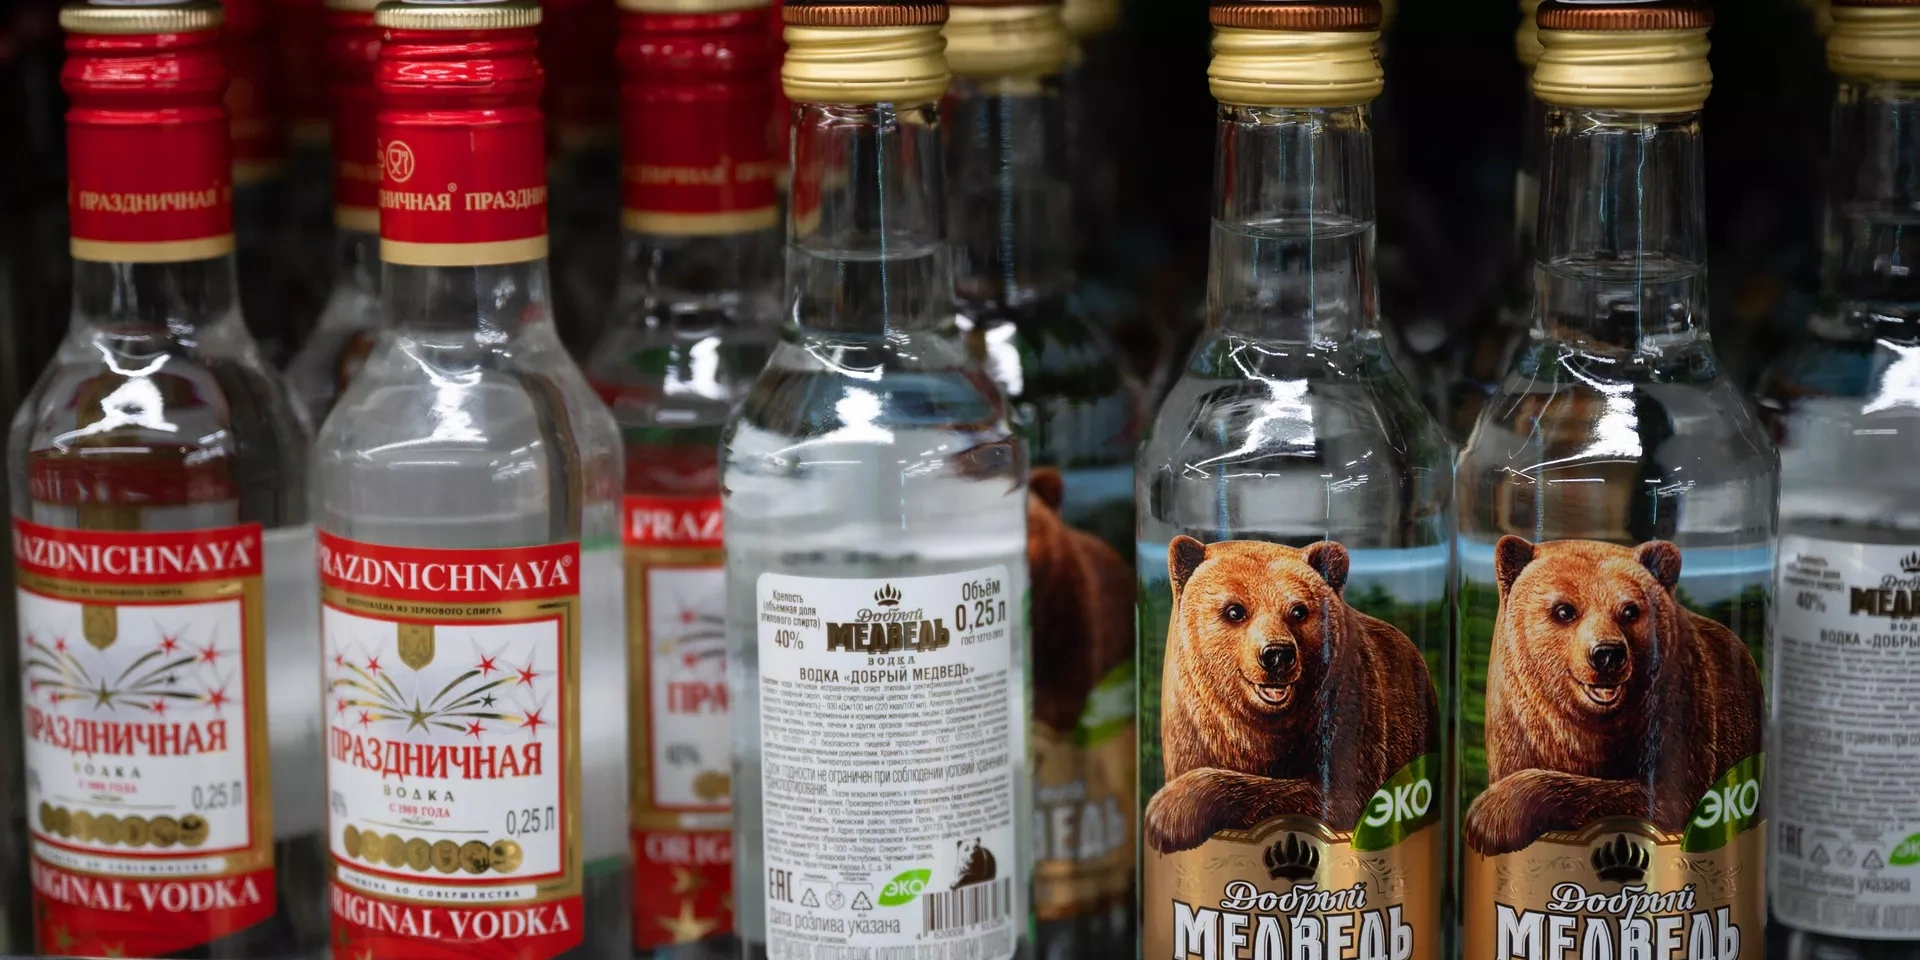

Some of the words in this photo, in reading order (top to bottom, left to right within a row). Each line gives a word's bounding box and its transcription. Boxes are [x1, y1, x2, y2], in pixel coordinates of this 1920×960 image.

[80, 189, 216, 215] ПРАЗДНИЧНАЯ
[772, 589, 803, 603] Крепость
[962, 579, 1000, 601] Объём
[410, 605, 463, 616] ЗЕРНОВОГО
[466, 606, 502, 616] СПИРТА
[799, 607, 816, 616] доля
[855, 608, 924, 625] Добрый
[955, 599, 994, 633] 0,25
[998, 600, 1006, 622] л
[793, 617, 820, 630] спирта)
[775, 629, 804, 649] 40%
[826, 618, 950, 654] МЕДВЕДЬ
[961, 635, 975, 646] ГОСТ
[1820, 629, 1860, 645] ВОДКА
[867, 656, 916, 666] ВОДКА
[800, 667, 839, 683] ВОДКА
[844, 666, 907, 684] «ДОБРЫЙ
[912, 663, 975, 681] МЕДВЕДЬ»
[856, 722, 876, 730] других
[331, 726, 542, 781] ПРАЗДНИЧНАЯ
[818, 770, 827, 782] не
[828, 769, 873, 786] ограничен
[875, 770, 891, 788] при
[892, 766, 943, 784] соблюдении
[945, 759, 975, 782] условий
[192, 783, 229, 811] 0,25
[383, 785, 455, 802] ВОДКА
[1363, 778, 1433, 828] ЭКО
[1694, 778, 1760, 829] ЭКО
[421, 806, 451, 817] ГОДА
[506, 808, 541, 838] 0,25
[544, 807, 554, 832] Л
[138, 877, 260, 913] VODKA
[418, 888, 520, 899] СОВЕРШЕНСТВА
[884, 880, 924, 897] ЭКО
[1220, 880, 1368, 929] Добрый
[1547, 881, 1697, 930] Добрый
[448, 904, 570, 940] VODKA
[795, 914, 845, 934] розлива
[847, 917, 900, 938] указана
[1172, 899, 1414, 960] МЕДВЕДЬ
[1494, 900, 1741, 960] МЕДВЕДЬ
